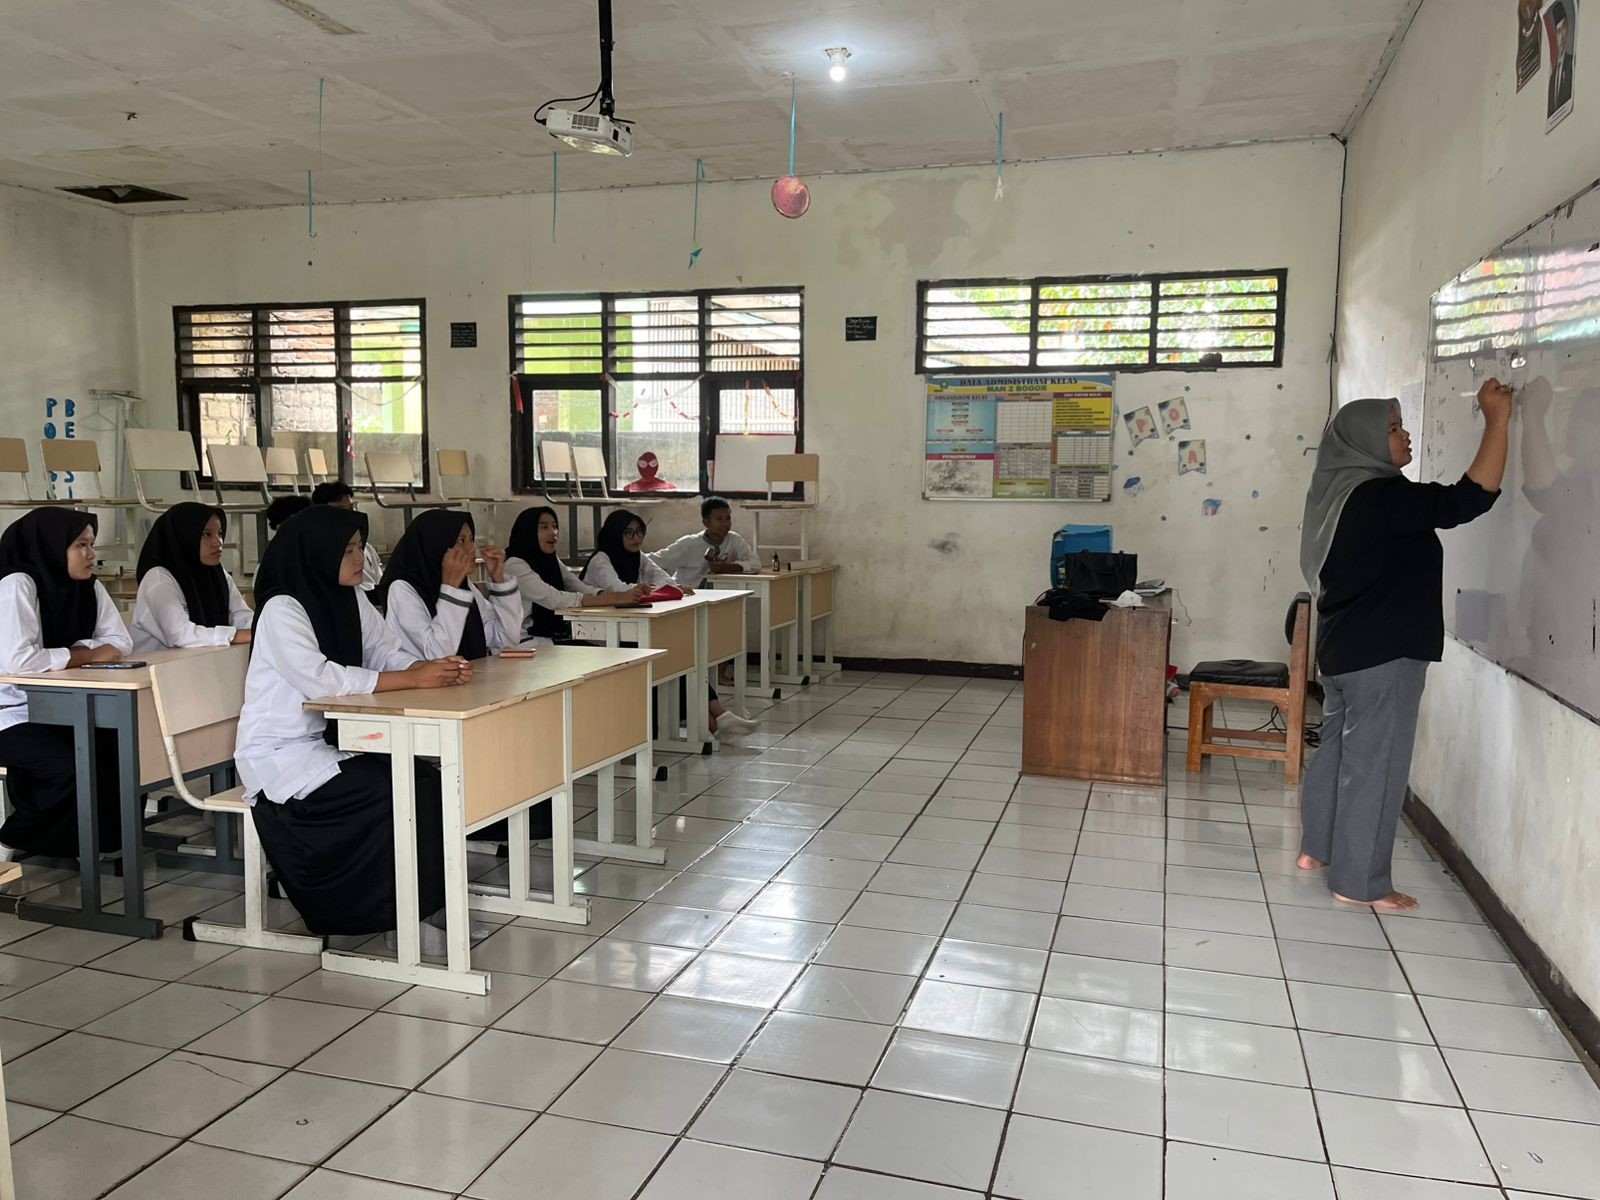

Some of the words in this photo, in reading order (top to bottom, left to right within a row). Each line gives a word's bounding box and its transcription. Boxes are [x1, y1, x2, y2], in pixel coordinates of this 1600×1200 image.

[960, 378, 982, 387] DATA
[985, 377, 1048, 386] ADMINISTRASI
[1050, 377, 1078, 385] KELAS
